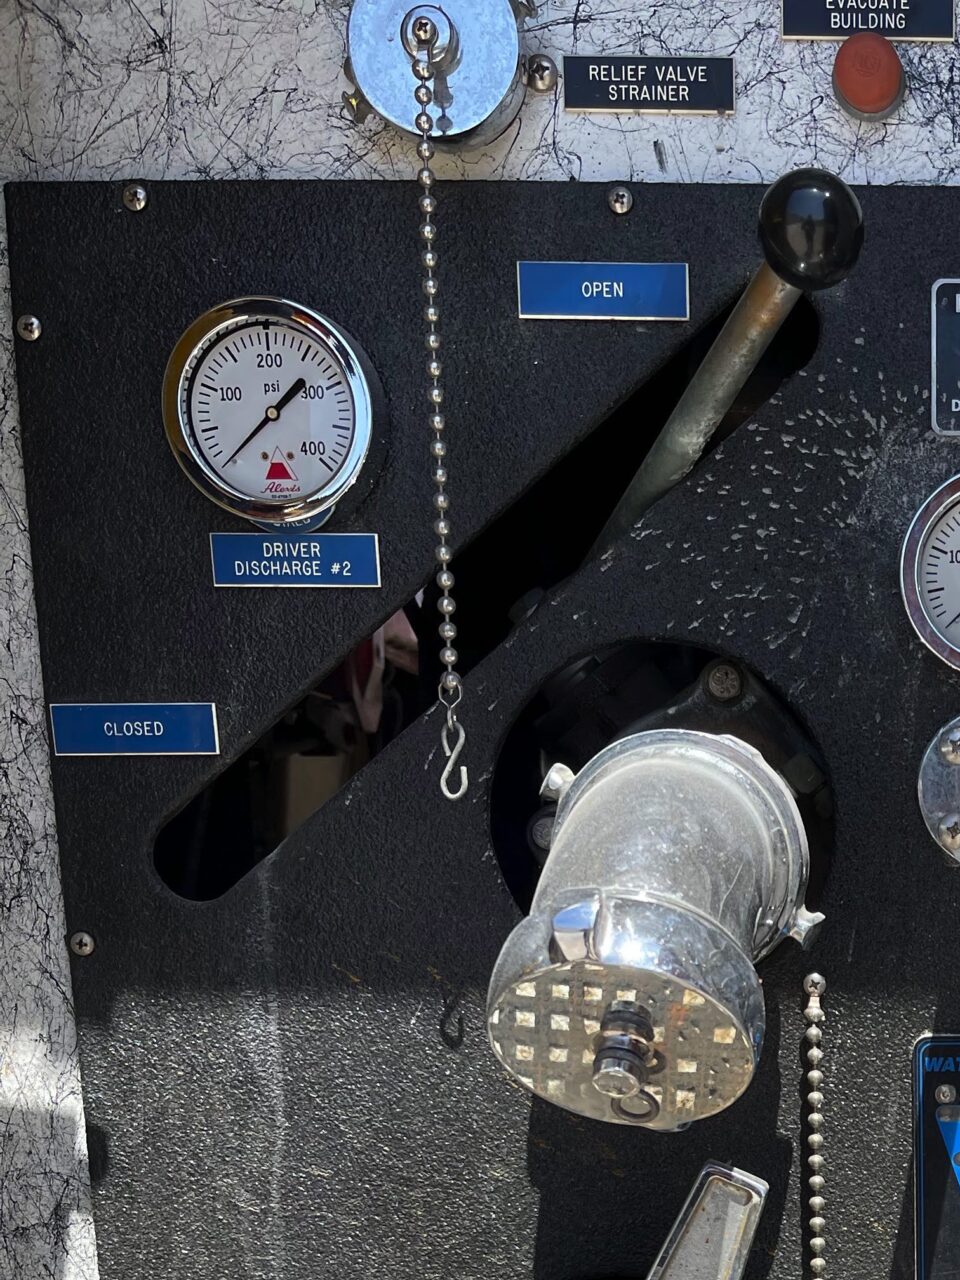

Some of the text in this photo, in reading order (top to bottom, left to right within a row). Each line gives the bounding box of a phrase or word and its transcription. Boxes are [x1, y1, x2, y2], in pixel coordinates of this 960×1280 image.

[830, 13, 906, 29] BUILDING
[588, 66, 707, 83] RELIEF VALVE
[608, 84, 690, 102] STRAINER
[581, 281, 624, 299] OPEN
[256, 354, 282, 368] 200
[220, 387, 242, 402] 100
[264, 380, 280, 394] psi
[300, 385, 324, 400] 300
[300, 442, 326, 456] 400
[263, 542, 321, 558] DRIVER
[234, 561, 352, 576] DISCHARGE #2
[104, 721, 164, 736] CLOSED
